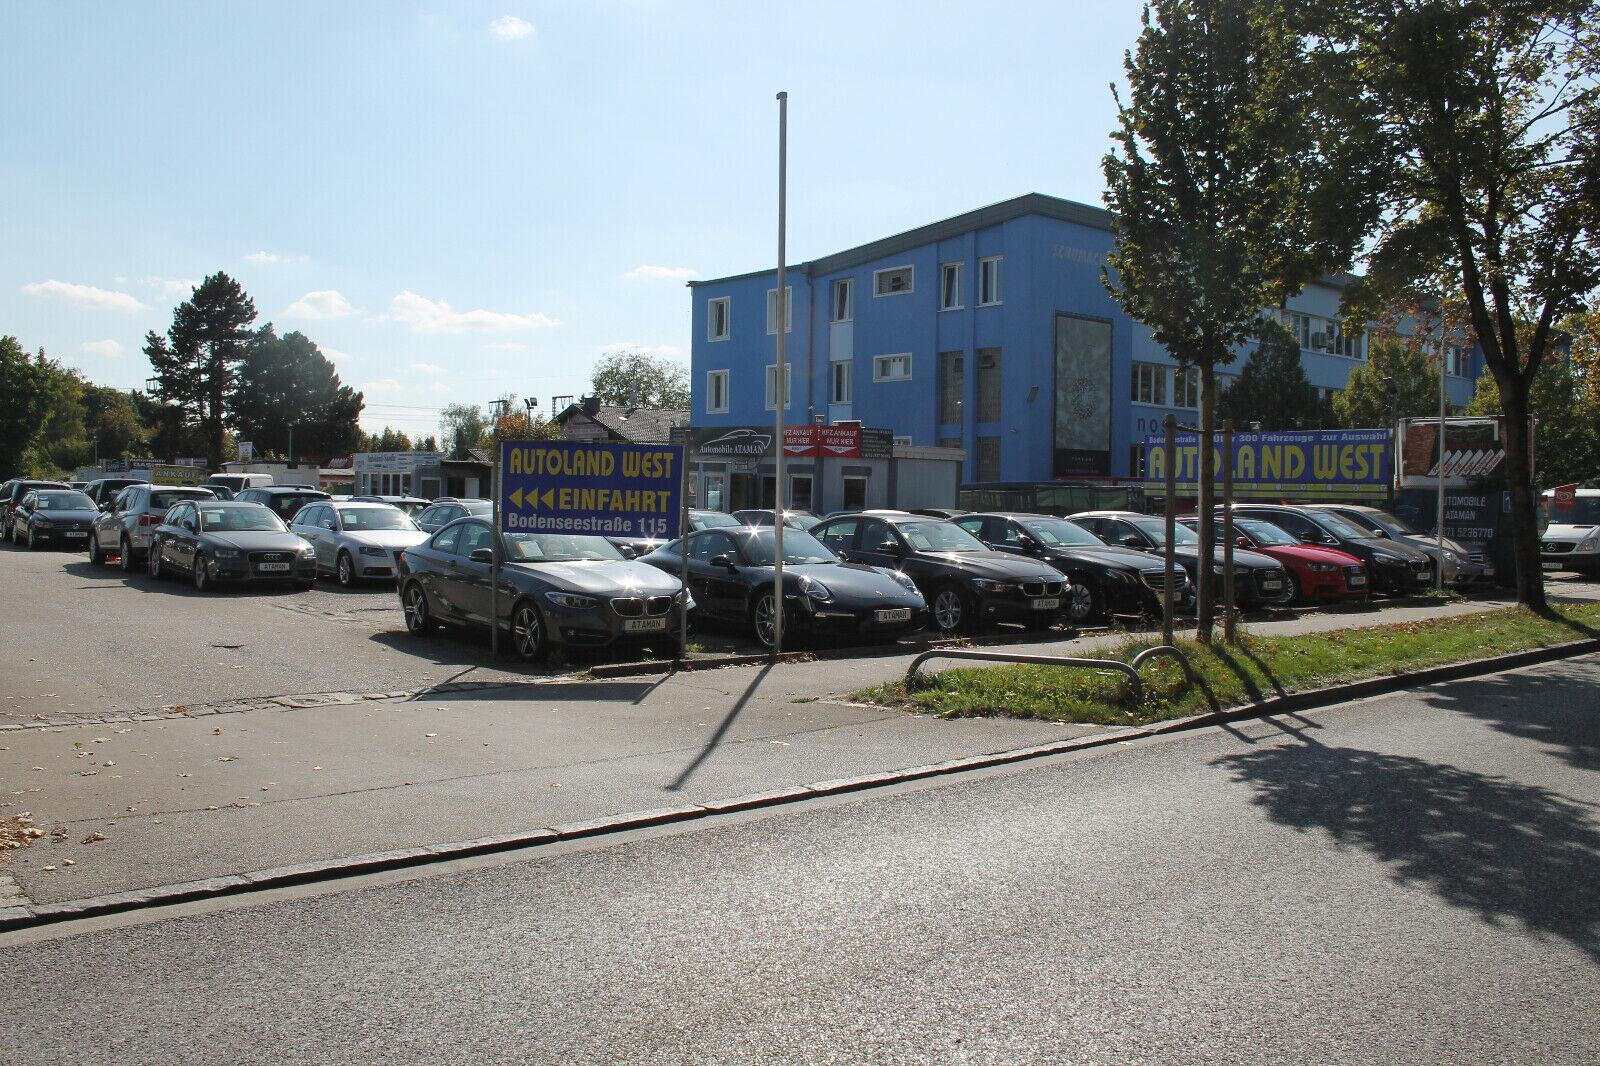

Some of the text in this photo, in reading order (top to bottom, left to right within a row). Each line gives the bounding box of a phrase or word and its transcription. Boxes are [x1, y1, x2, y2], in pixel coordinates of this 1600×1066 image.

[1261, 433, 1314, 444] Fahrzeuge
[1341, 432, 1387, 442] Auswahl
[699, 444, 763, 454] Automobile ATAMAN
[509, 447, 674, 479] AUTOLAND WEST
[1149, 444, 1385, 481] AUTAND WEST
[558, 488, 671, 513] EINFAHRT
[1441, 496, 1486, 507] UTOMOBILE
[1445, 510, 1476, 520] ATAMAN
[508, 513, 668, 534] Bodenseestraße 115
[883, 611, 907, 620] ATAMAN
[631, 619, 661, 630] ATAMAN
